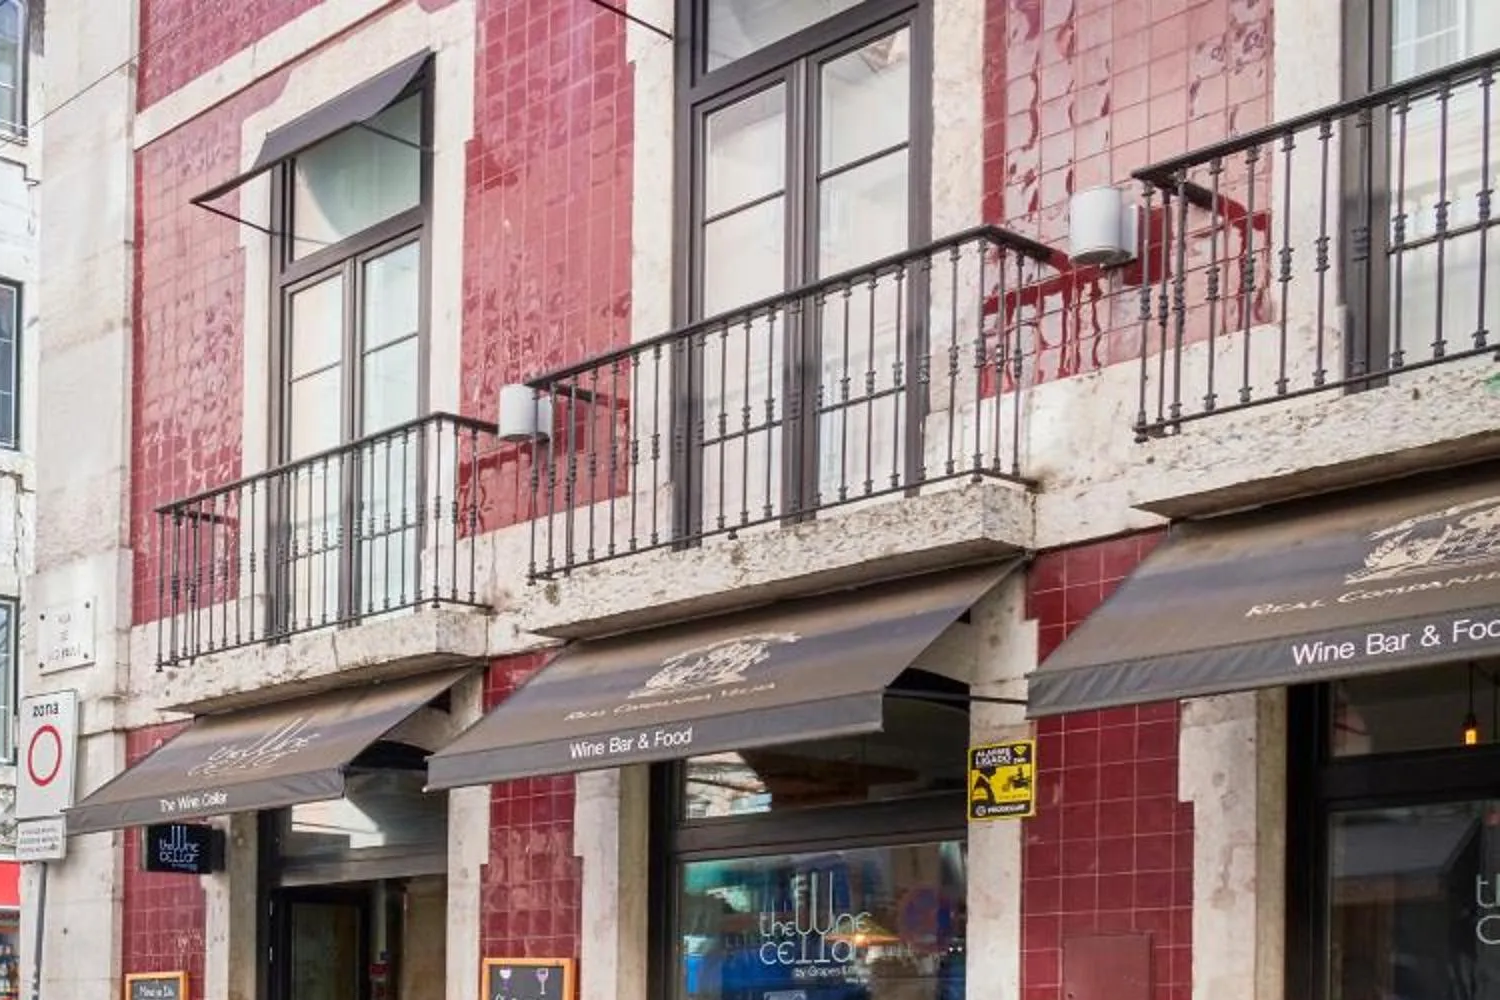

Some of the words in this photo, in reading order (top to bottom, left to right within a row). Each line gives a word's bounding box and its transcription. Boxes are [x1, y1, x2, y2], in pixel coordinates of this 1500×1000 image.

[1292, 640, 1355, 666] Wine
[1366, 632, 1411, 656] Bar
[1420, 624, 1441, 647] &
[1452, 619, 1500, 643] Foo
[32, 702, 59, 717] zona
[569, 741, 605, 759] Wine
[609, 736, 634, 753] Bar
[637, 732, 649, 749] &
[654, 727, 693, 747] Food
[177, 795, 200, 809] Wine
